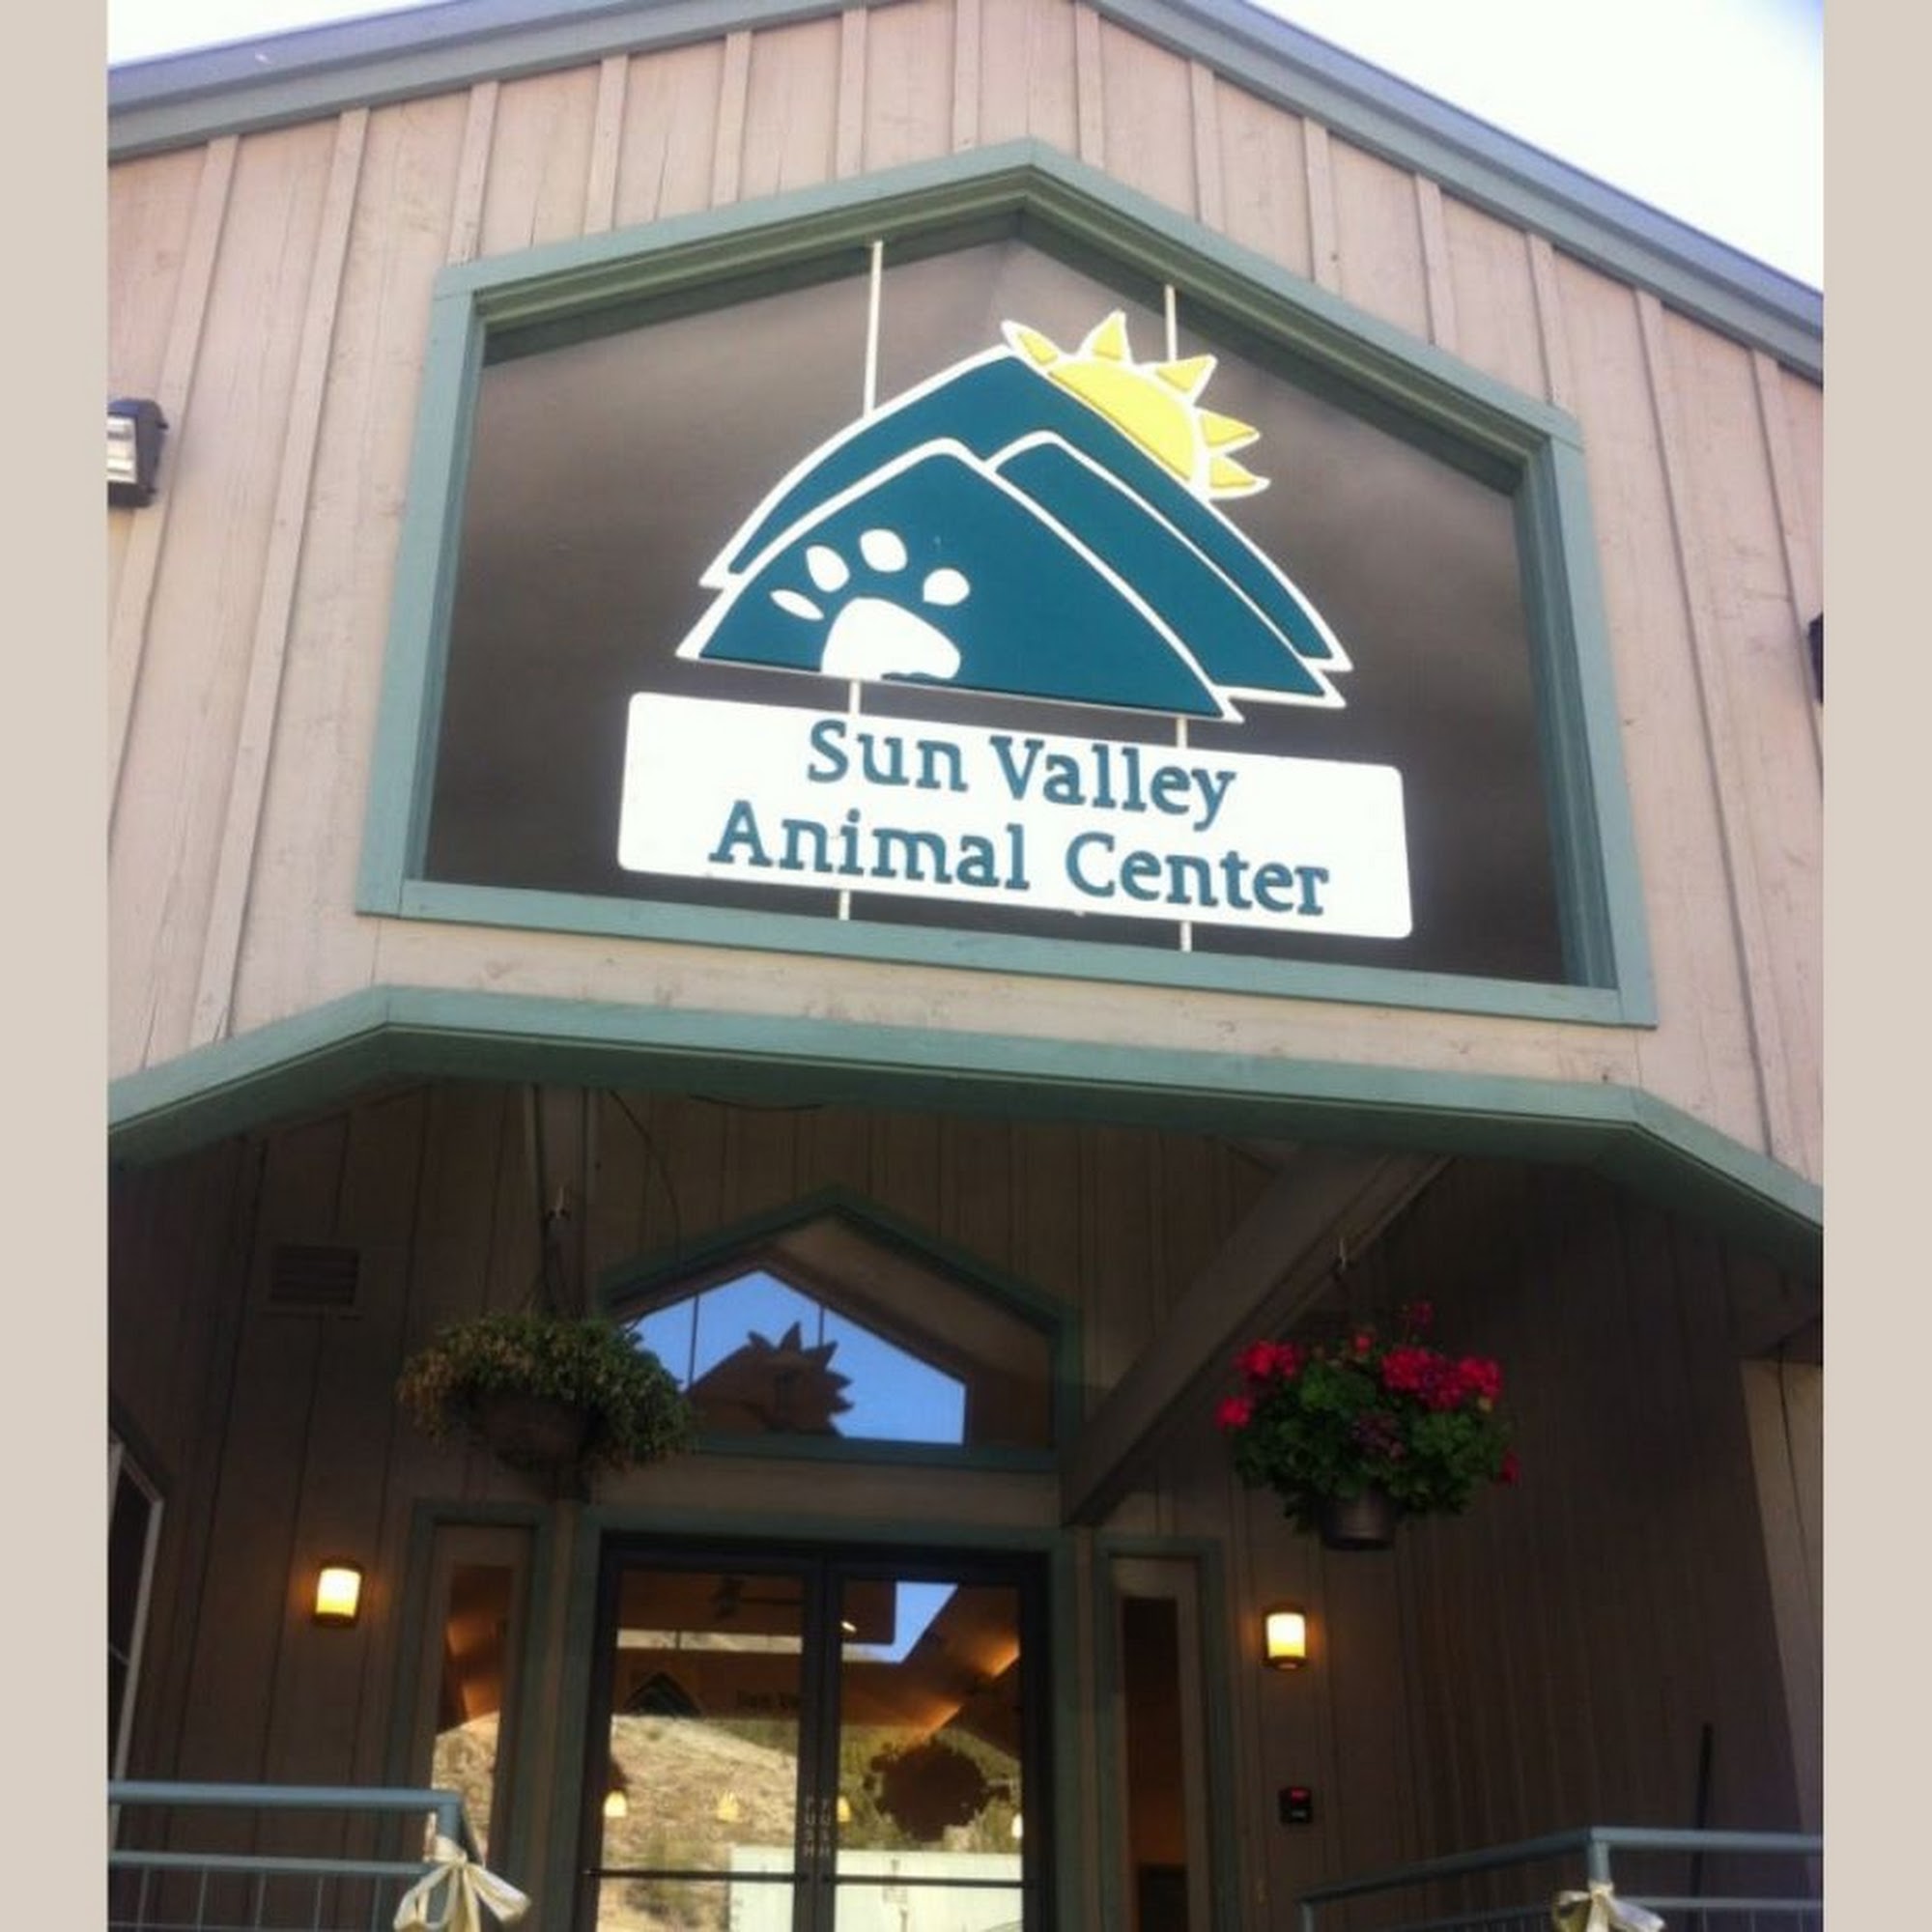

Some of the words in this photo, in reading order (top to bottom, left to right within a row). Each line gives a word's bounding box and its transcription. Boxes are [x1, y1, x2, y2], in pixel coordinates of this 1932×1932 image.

[807, 719, 968, 792] Sun
[989, 735, 1236, 833] Valley
[708, 800, 1030, 892] Animal
[1065, 832, 1330, 917] Center
